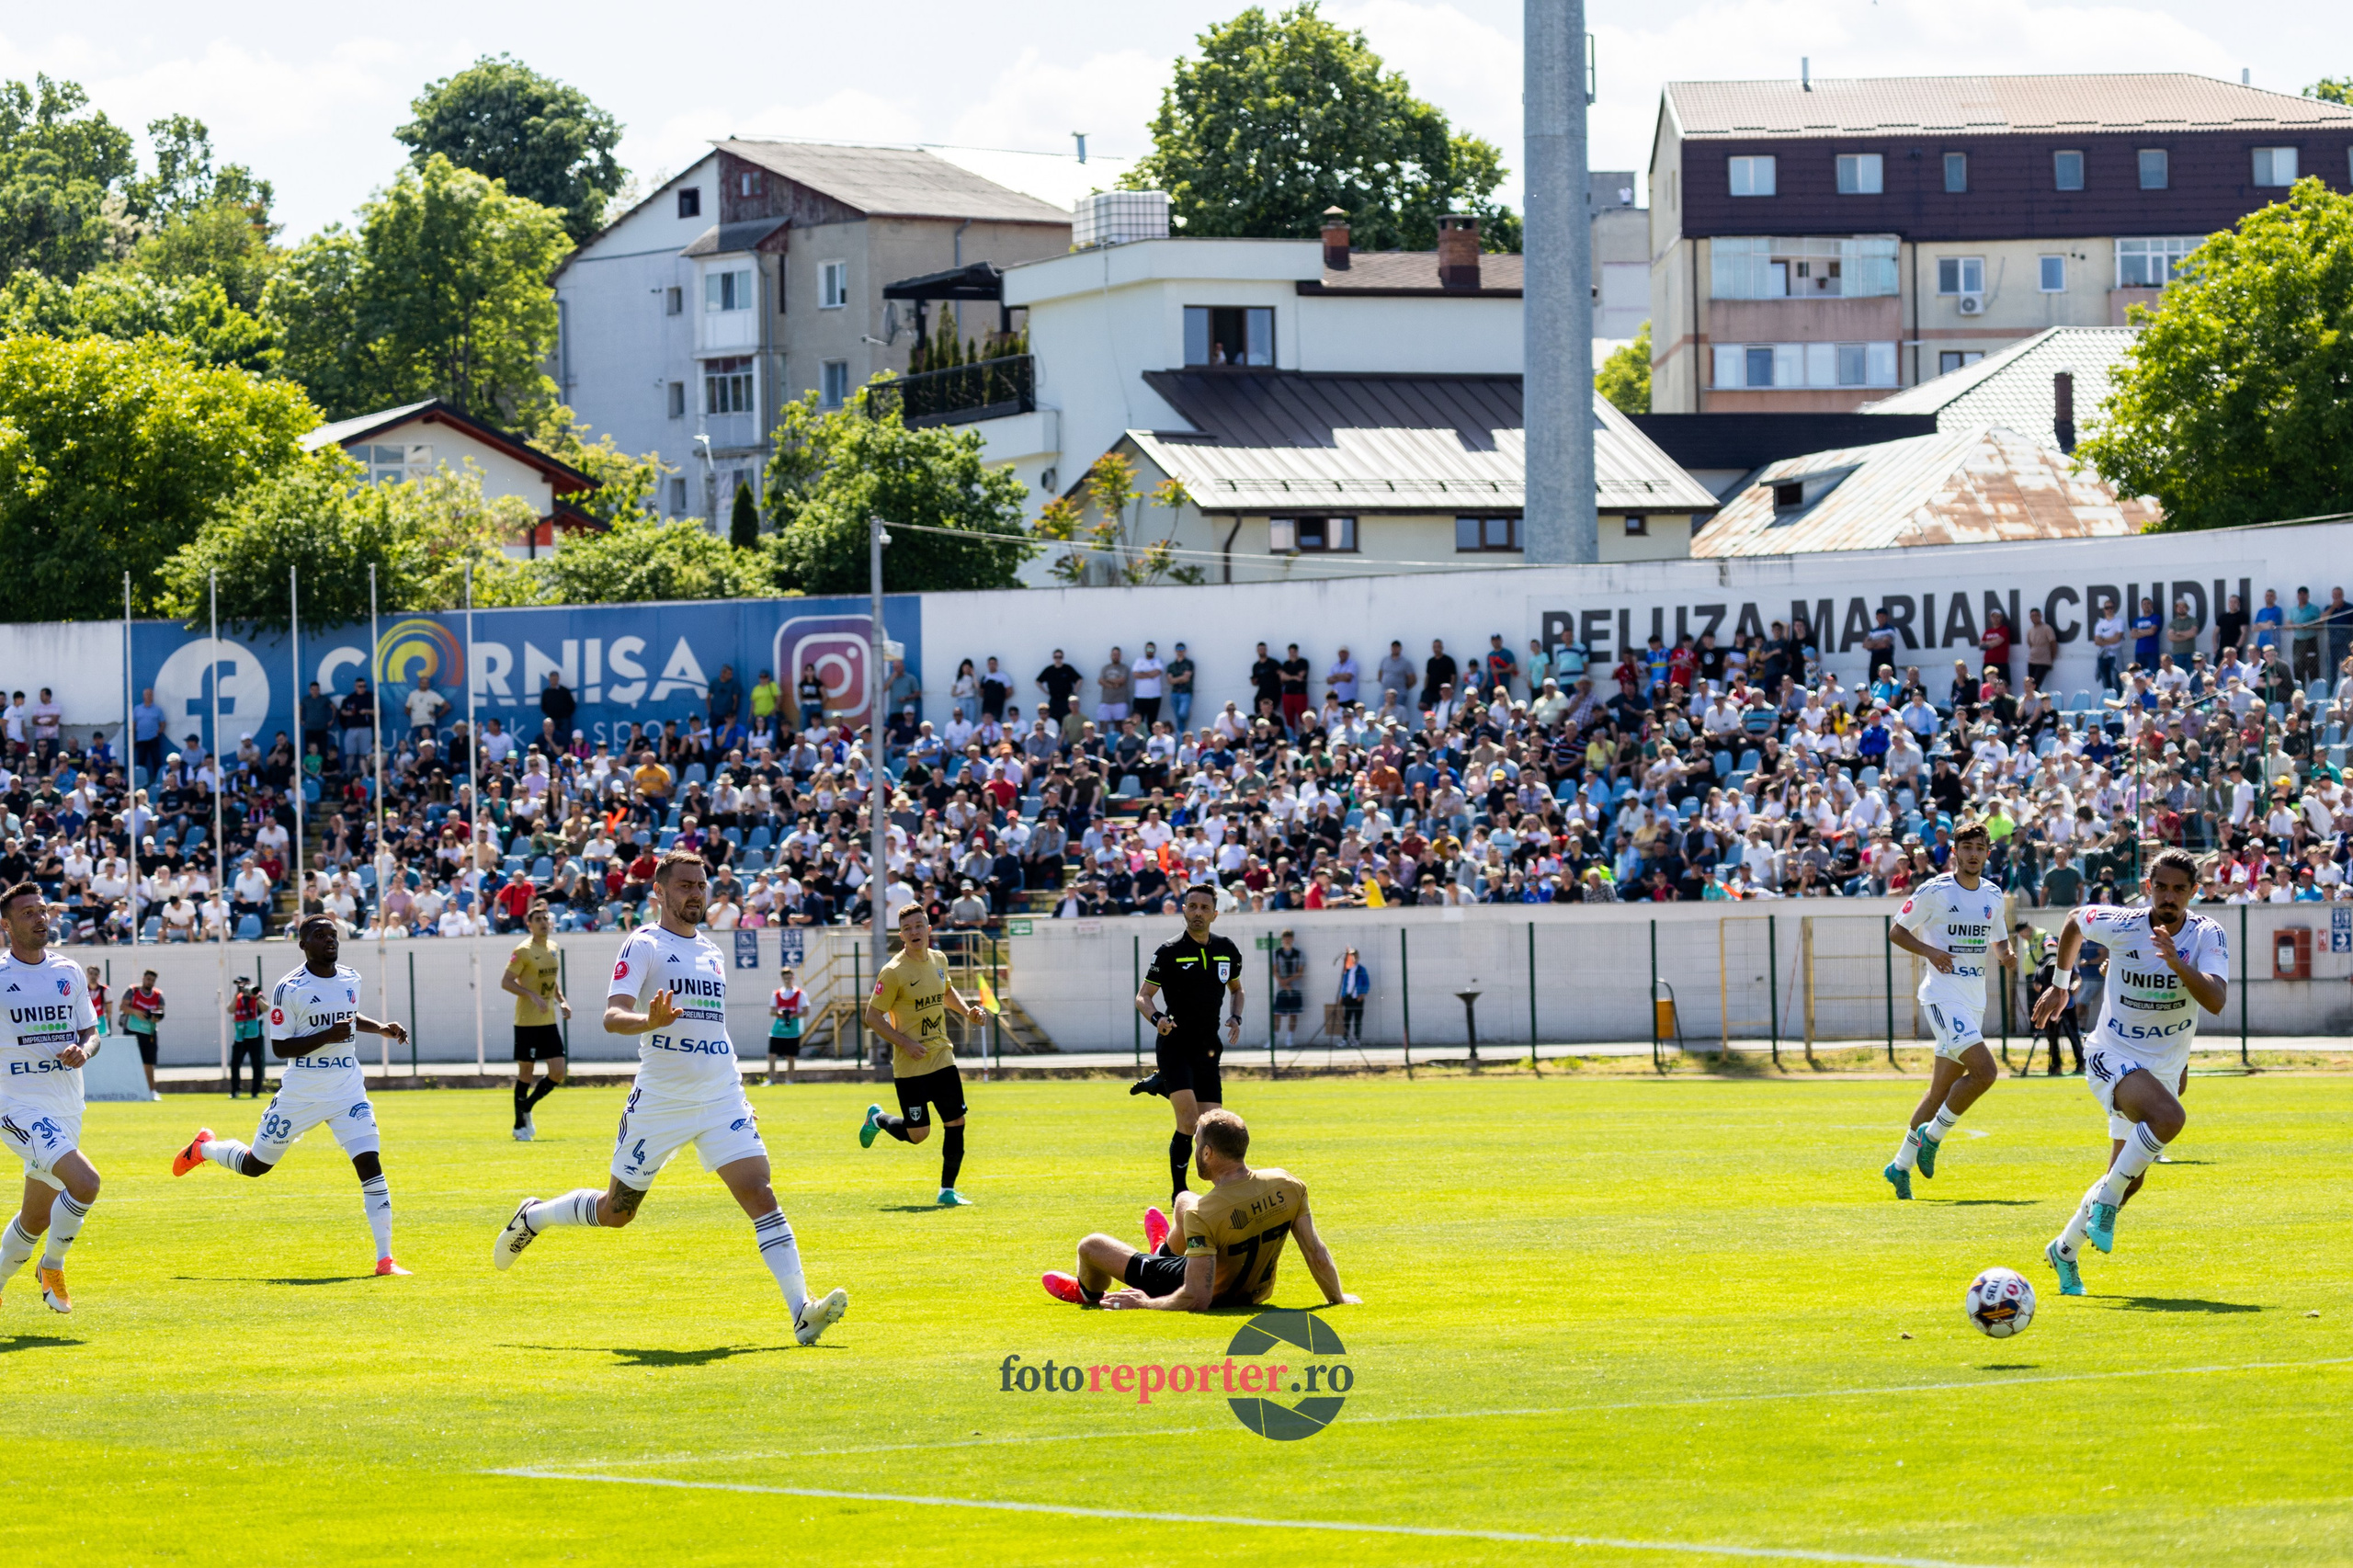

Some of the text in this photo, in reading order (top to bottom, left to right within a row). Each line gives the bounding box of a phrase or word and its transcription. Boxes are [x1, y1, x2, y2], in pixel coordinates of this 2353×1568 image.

[1541, 603, 1769, 664] PELUZA
[1790, 589, 2022, 653] MARIAN
[1944, 964, 1985, 977] LSAC
[2121, 968, 2187, 990] UNIBE
[915, 993, 945, 1010] MAXB
[1952, 1016, 1965, 1034] 6
[2108, 1017, 2192, 1040] ELSACO
[651, 1034, 730, 1055] ELSACO
[10, 1059, 74, 1075] ELSA
[295, 1056, 355, 1069] ELSAC
[31, 1117, 63, 1140] 30
[267, 1114, 291, 1139] 83
[631, 1138, 646, 1165] 4
[1250, 1190, 1285, 1216] HILS
